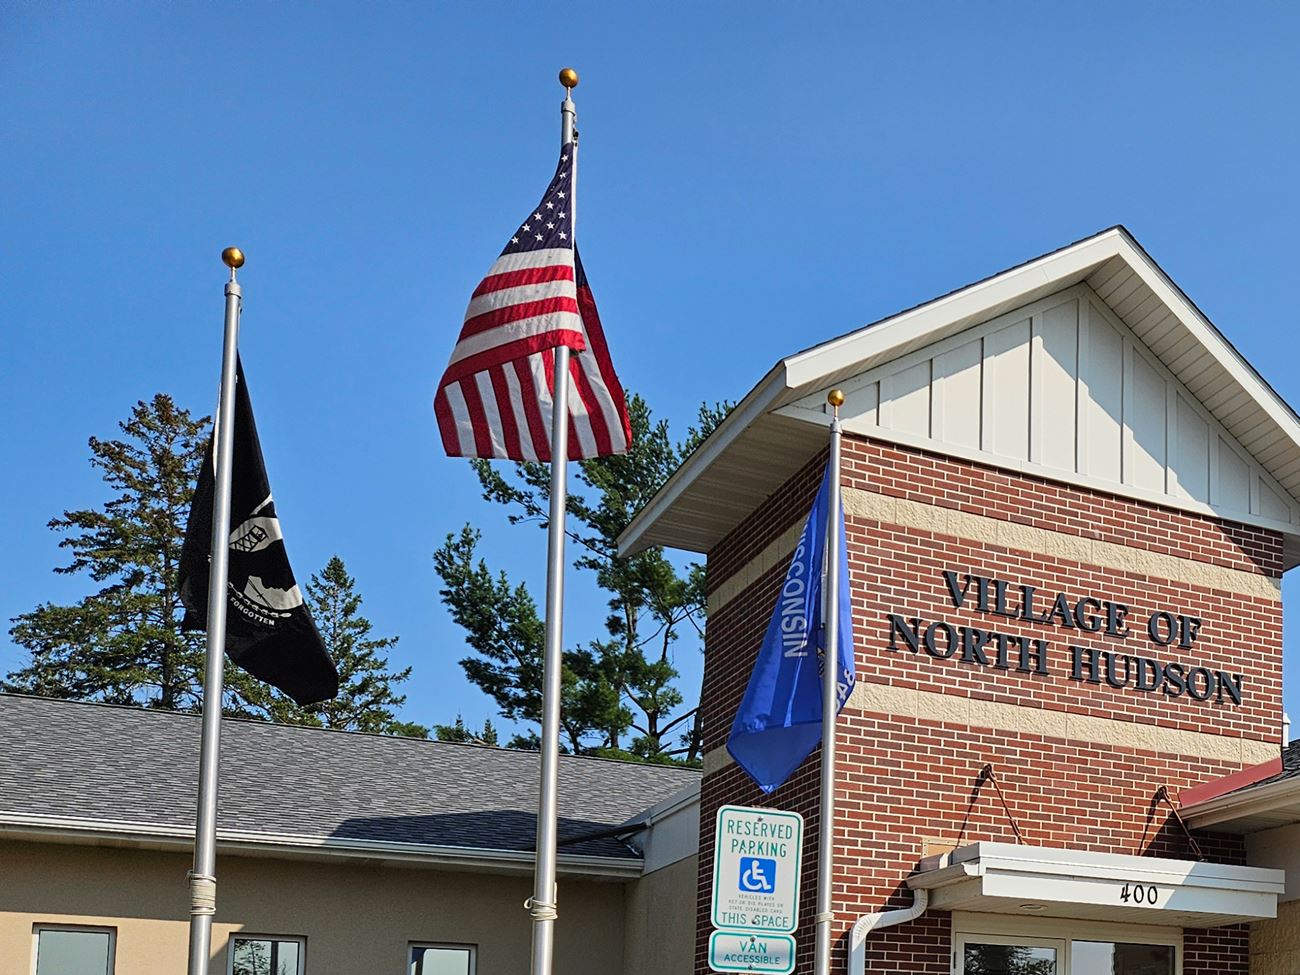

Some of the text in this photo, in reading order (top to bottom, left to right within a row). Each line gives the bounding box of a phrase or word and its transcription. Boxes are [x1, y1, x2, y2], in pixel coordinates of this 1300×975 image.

[781, 515, 808, 658] SCONSIN
[230, 597, 275, 626] FORGOTTEN
[942, 570, 1201, 650] VILLAGE OF
[886, 613, 1244, 706] NORTH HUDSON
[727, 819, 793, 840] RESERVED
[731, 838, 787, 858] PARKING
[1120, 883, 1158, 905] 400
[721, 911, 789, 928] THIS SPACE
[739, 941, 767, 954] VAN
[723, 953, 781, 965] ACCESSIBLE
